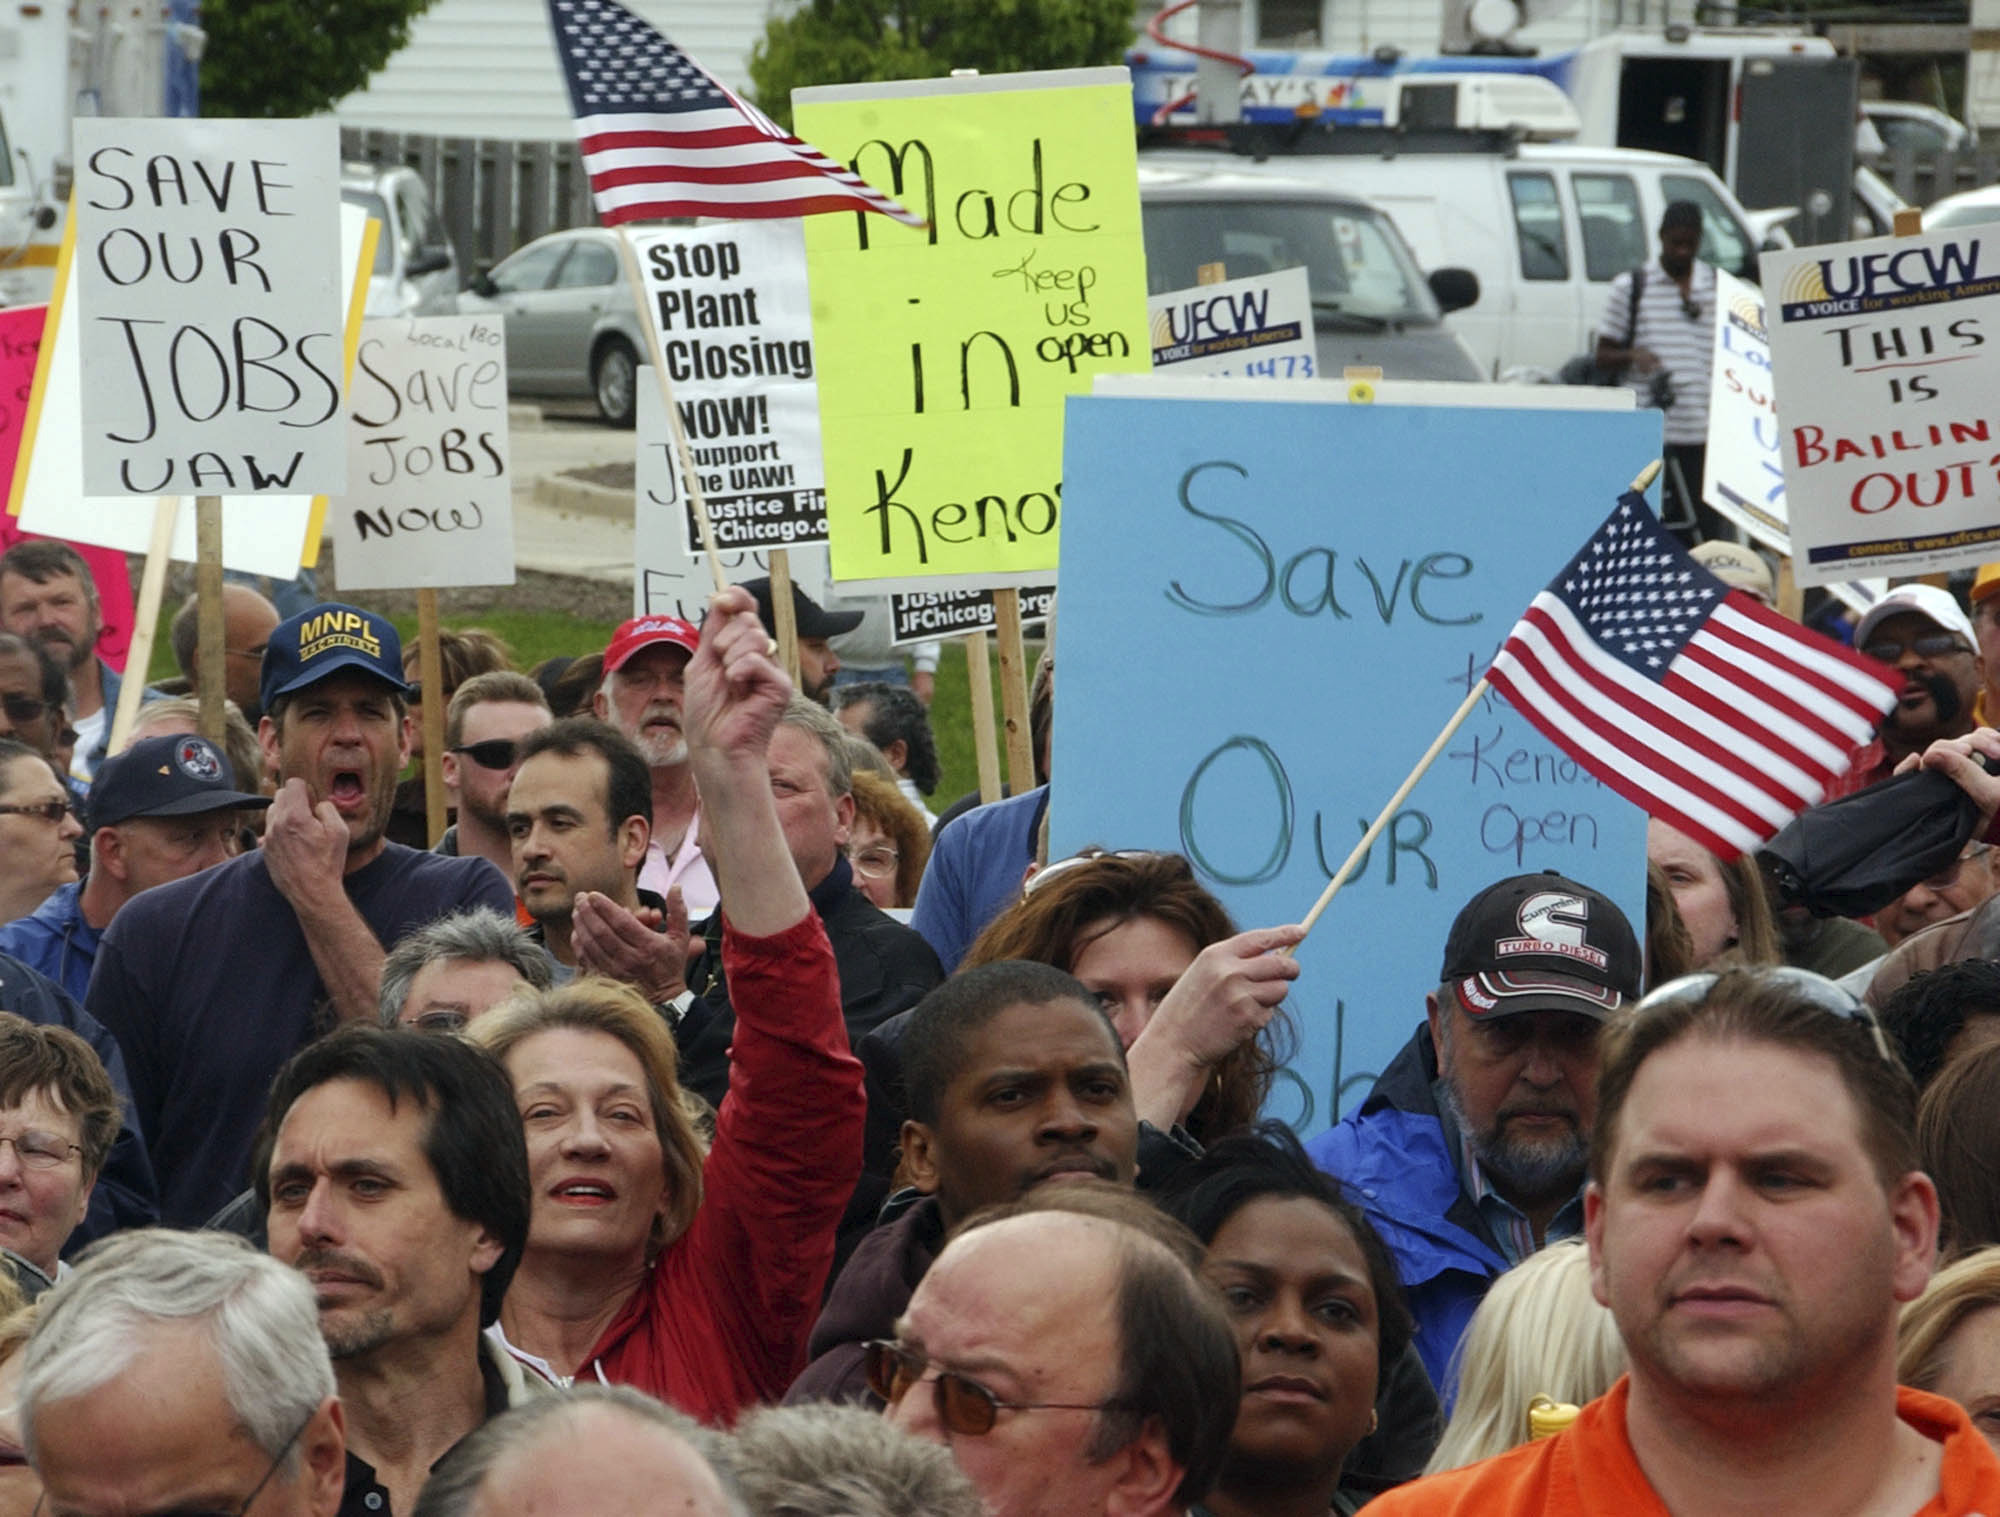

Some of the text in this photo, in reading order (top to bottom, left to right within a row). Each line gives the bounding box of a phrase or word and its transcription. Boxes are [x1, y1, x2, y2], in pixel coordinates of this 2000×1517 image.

[1163, 79, 1318, 107] TAY'S
[87, 146, 296, 217] SAVE
[849, 137, 1100, 250] Made
[97, 227, 272, 293] OUR
[647, 241, 741, 281] Stop
[1817, 239, 1981, 297] UFCW
[657, 288, 760, 331] Plant
[1165, 288, 1268, 344] UFCW
[1793, 306, 1805, 318] a
[1807, 299, 1860, 316] VOICE
[1862, 298, 1885, 311] for
[1890, 288, 1951, 306] working
[666, 336, 814, 382] Closing
[907, 297, 1020, 415] in
[1036, 331, 1129, 374] open
[1823, 319, 1985, 367] THIS
[95, 316, 339, 444] JOBS
[352, 338, 501, 428] Save
[1889, 375, 1939, 404] IS
[676, 394, 770, 440] NOW!
[1793, 418, 1992, 468] BAILIN
[120, 451, 305, 494] UAW
[730, 464, 795, 490] UAW!
[353, 501, 483, 542] NOW
[694, 496, 784, 520] ustice
[863, 448, 1062, 564] Keno
[1163, 460, 1484, 627] Save
[300, 610, 380, 645] MNPL
[1448, 724, 1602, 790] Keno
[1480, 802, 1598, 869] Open
[1503, 941, 1554, 953] TURBO
